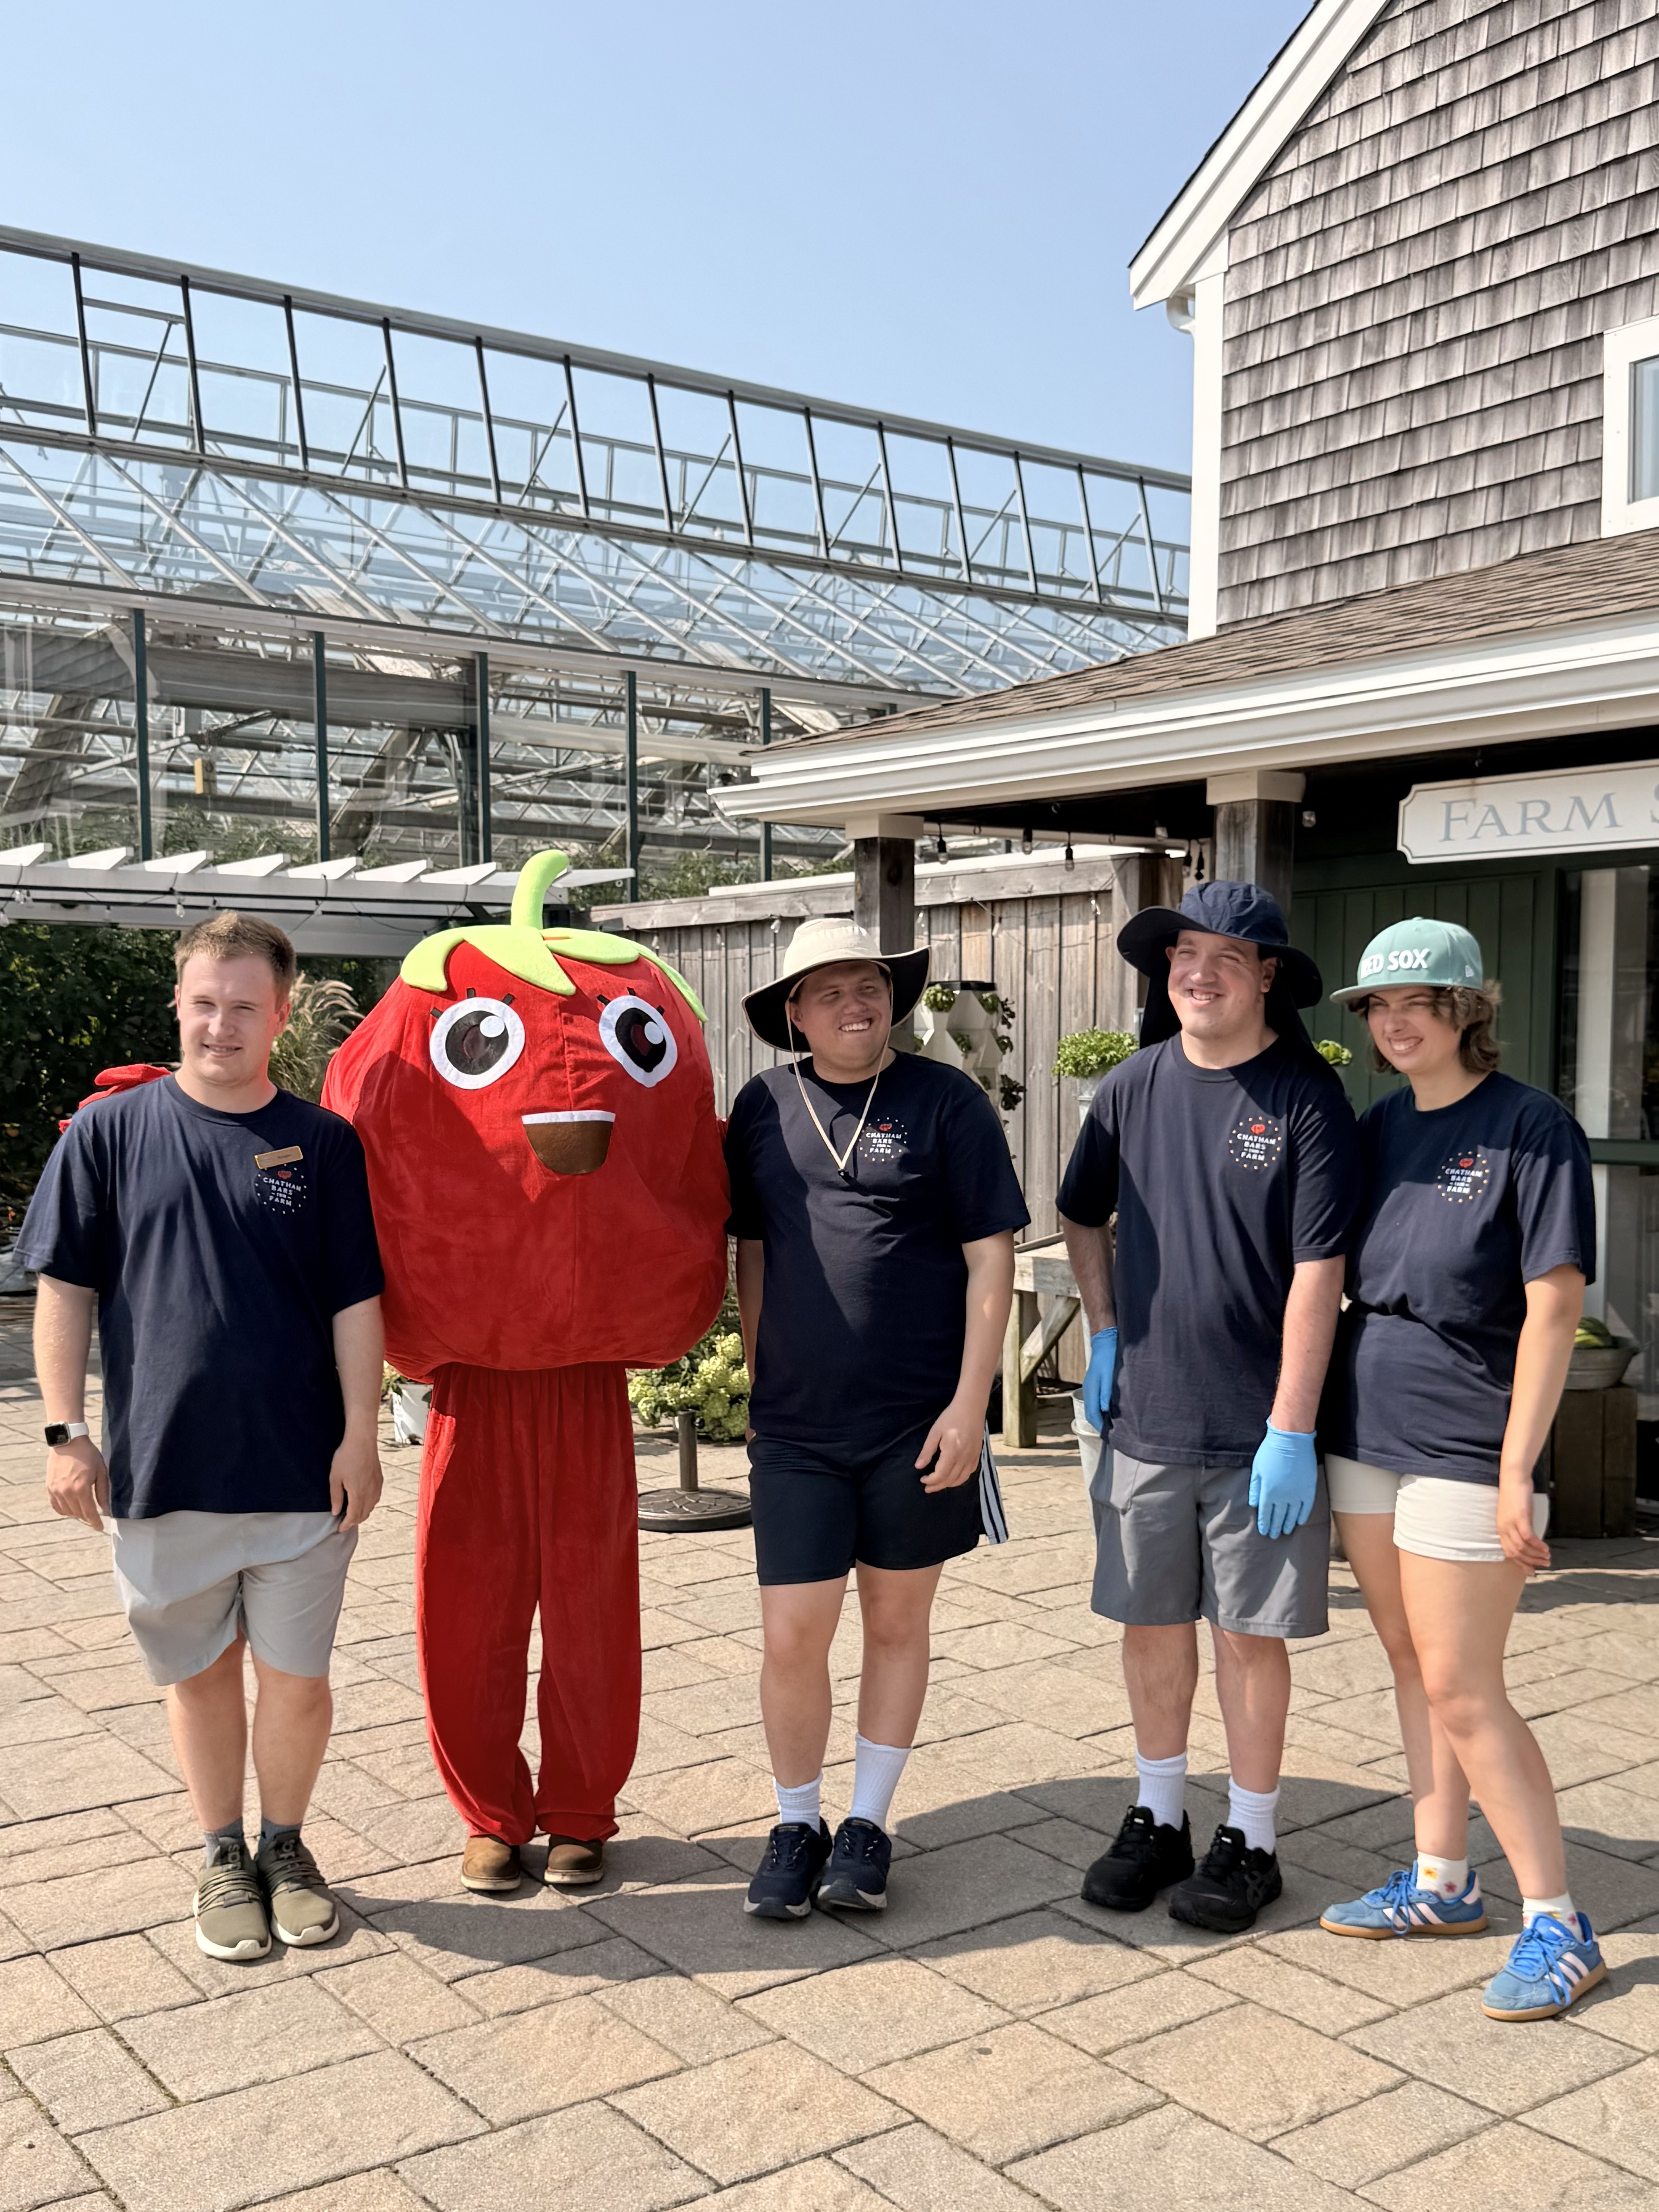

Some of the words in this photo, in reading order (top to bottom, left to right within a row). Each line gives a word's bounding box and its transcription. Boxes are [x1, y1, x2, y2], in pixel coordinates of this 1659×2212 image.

[1438, 793, 1623, 842] FARM
[1387, 948, 1430, 970] SOX
[1237, 1133, 1276, 1144] CHATHAM
[1244, 1141, 1266, 1150] BARS
[1241, 1151, 1265, 1161] FARM
[1445, 1168, 1483, 1177] CHATHAM
[263, 1177, 301, 1191] CHATHAM
[272, 1185, 293, 1195] BARS
[1446, 1185, 1470, 1194] FARM
[269, 1195, 292, 1206] FARM
